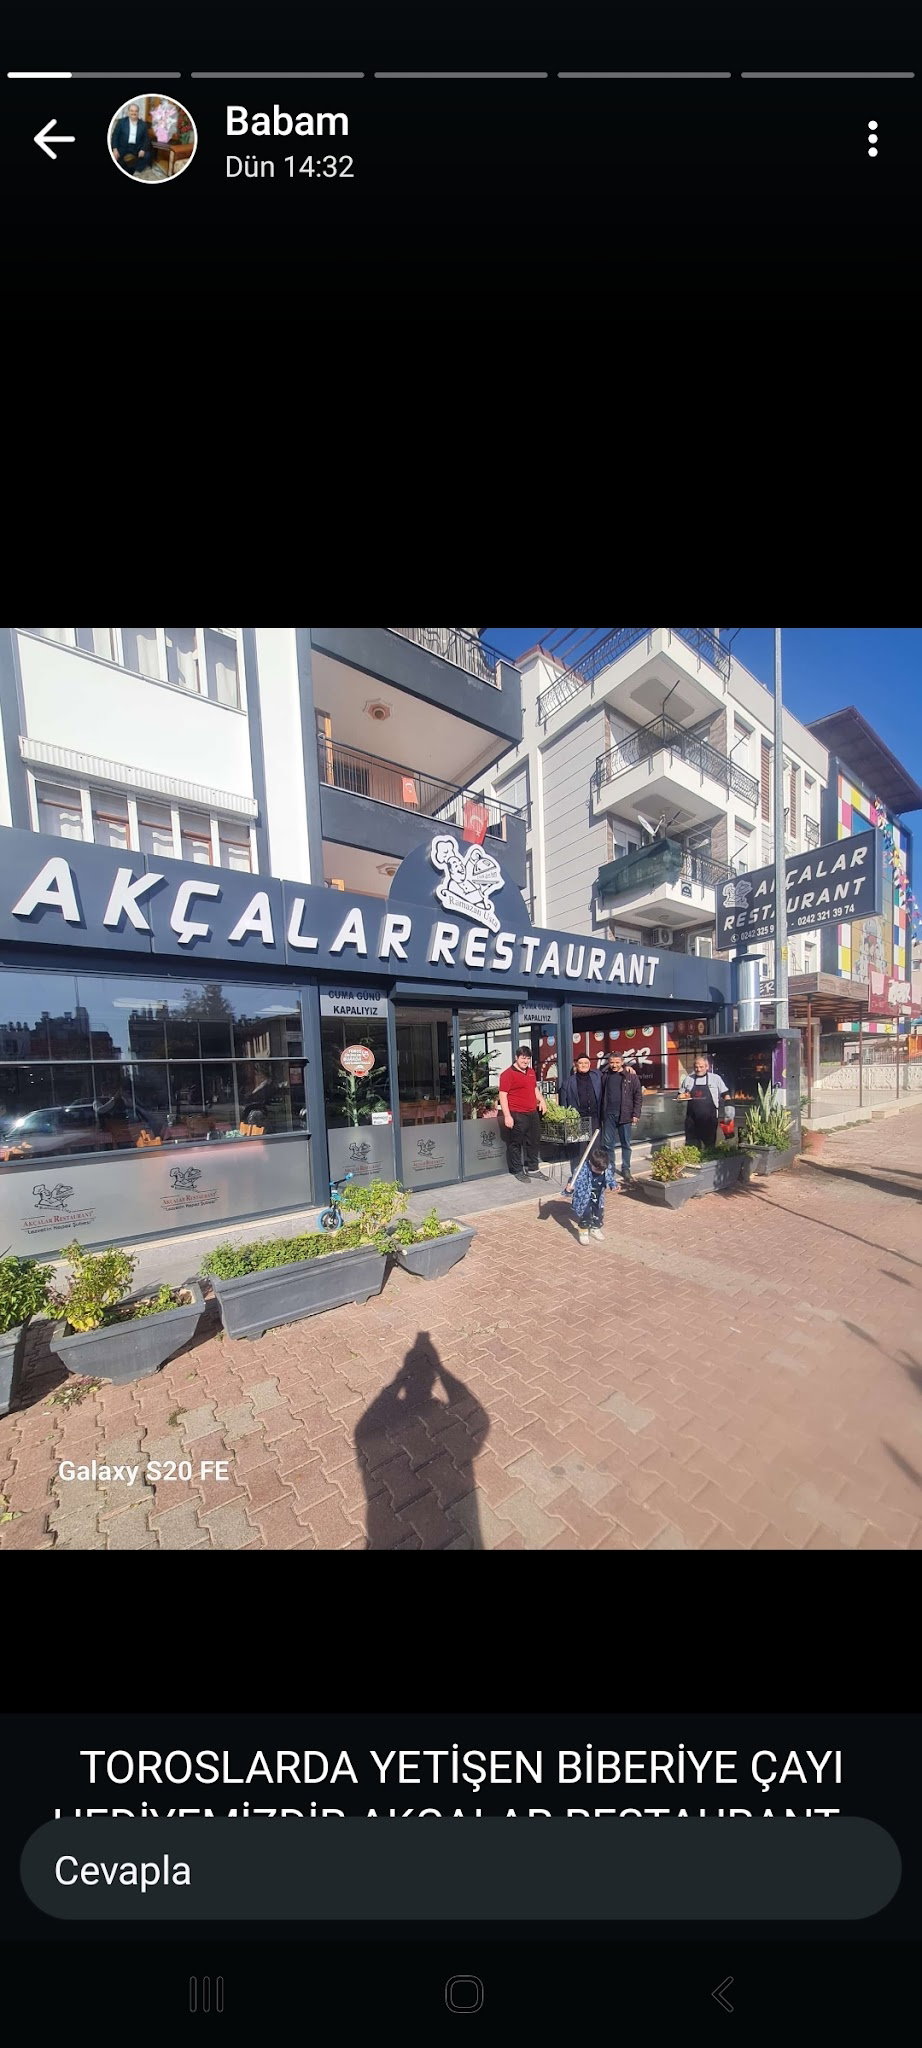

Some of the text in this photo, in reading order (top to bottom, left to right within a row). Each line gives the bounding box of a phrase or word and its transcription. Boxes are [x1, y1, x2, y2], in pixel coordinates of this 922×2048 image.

[449, 895, 482, 917] Ramazan
[12, 857, 660, 986] AKÇALAR RESTAURANT
[741, 930, 756, 940] 0242
[757, 926, 769, 936] 325
[797, 915, 815, 926] 0242
[817, 910, 831, 921] 321
[833, 907, 843, 916] 39
[844, 903, 855, 914] 74
[328, 990, 381, 1001] CUMA GÜNÜ
[333, 1005, 378, 1015] KAPALIYIZ
[523, 1014, 551, 1022] KAPALIYIZ
[23, 1211, 94, 1228] AKÇALAR RESTAURANT
